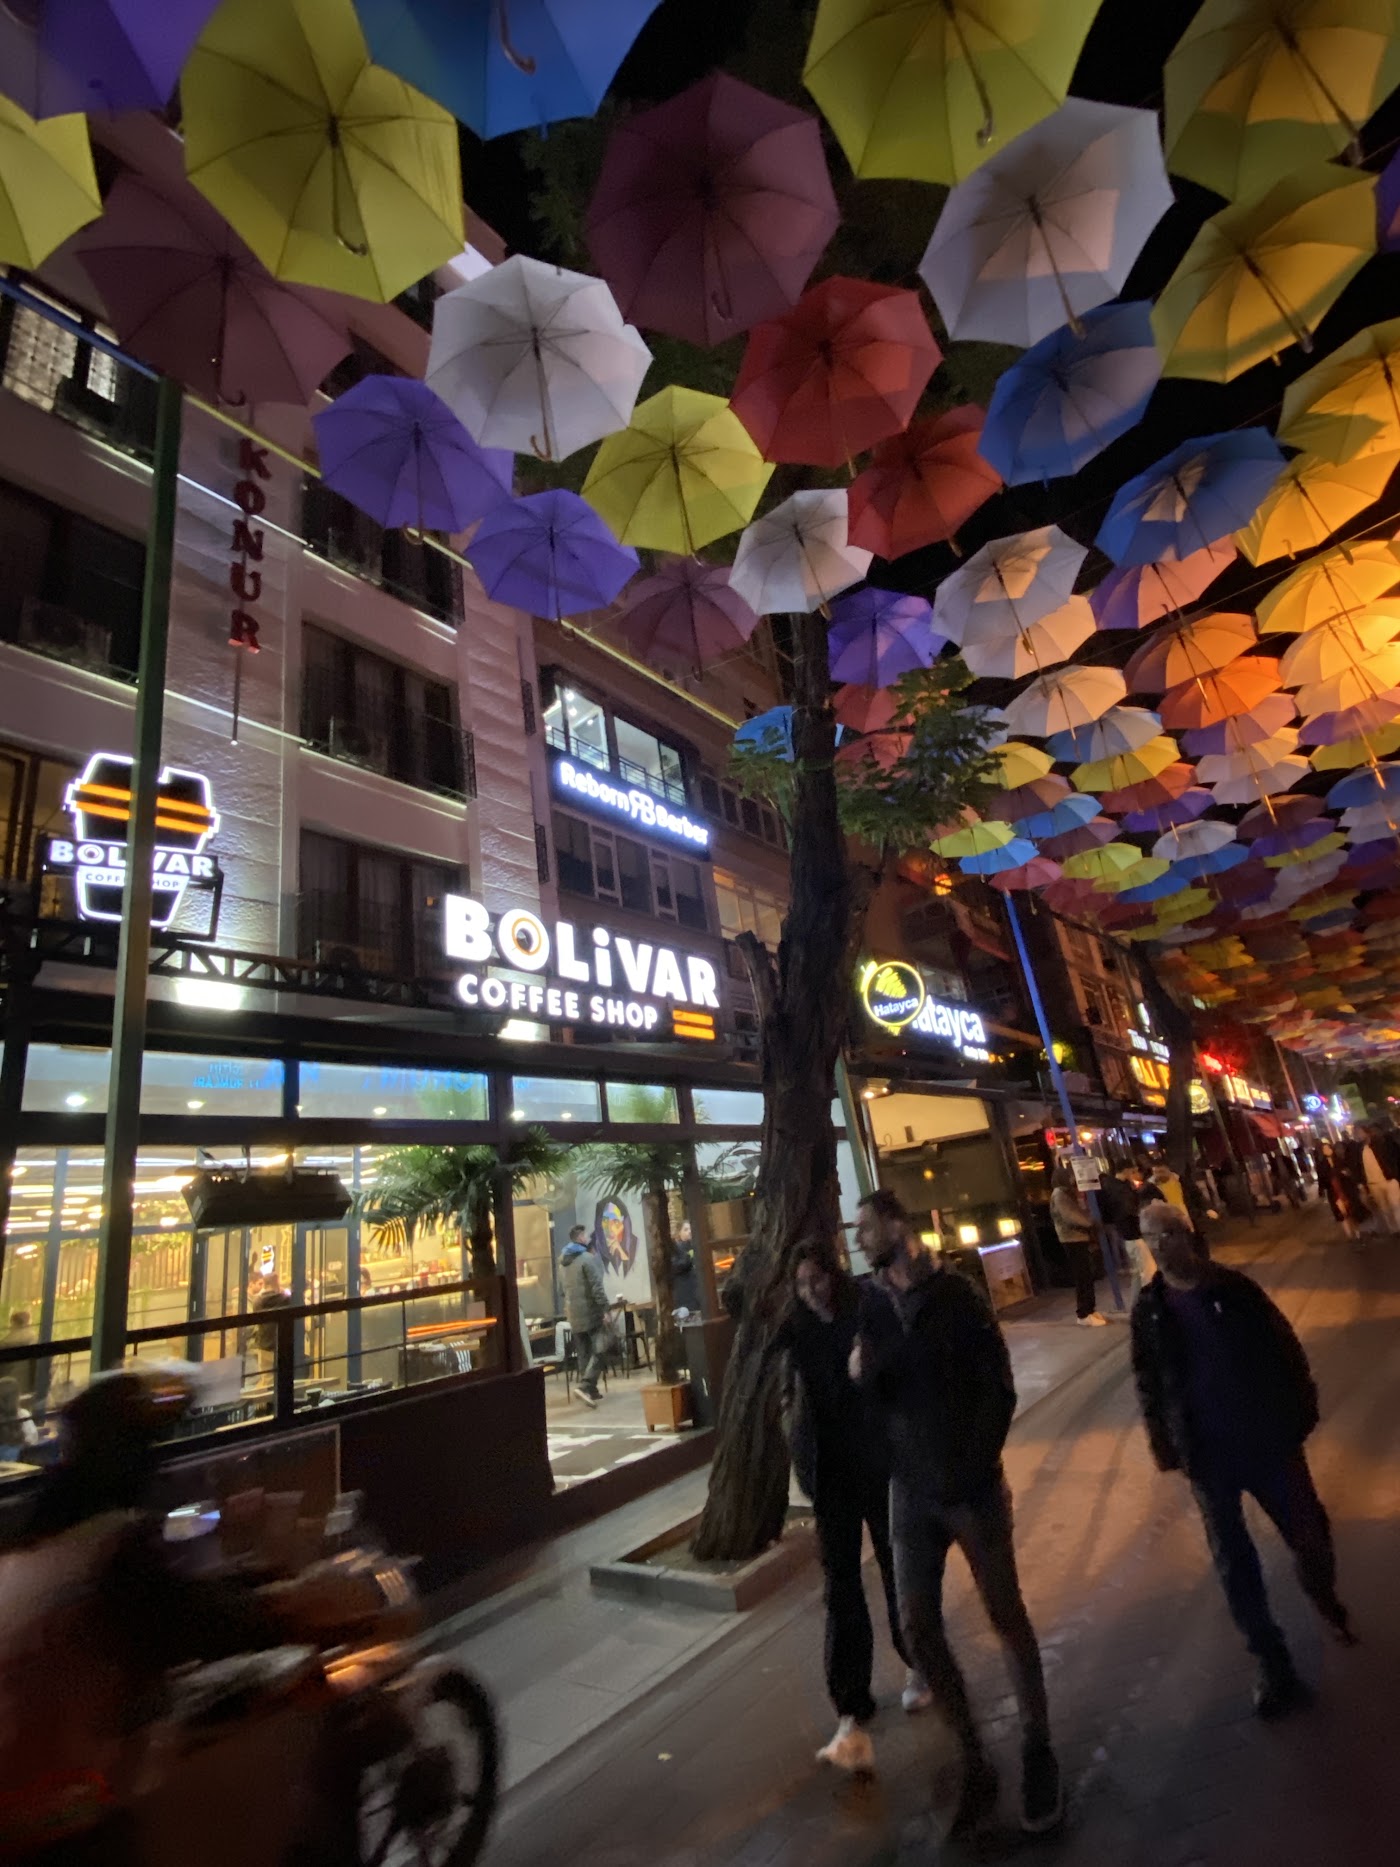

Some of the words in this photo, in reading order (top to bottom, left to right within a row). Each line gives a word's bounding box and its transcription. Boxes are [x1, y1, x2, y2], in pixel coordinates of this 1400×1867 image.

[228, 438, 272, 654] KONUR
[560, 761, 630, 812] Reborn
[50, 839, 215, 878] BOLVAR
[458, 973, 580, 1019] COFFEE
[590, 995, 658, 1030] SHOP
[873, 998, 919, 1017] Hatayca
[912, 994, 986, 1048] atayca
